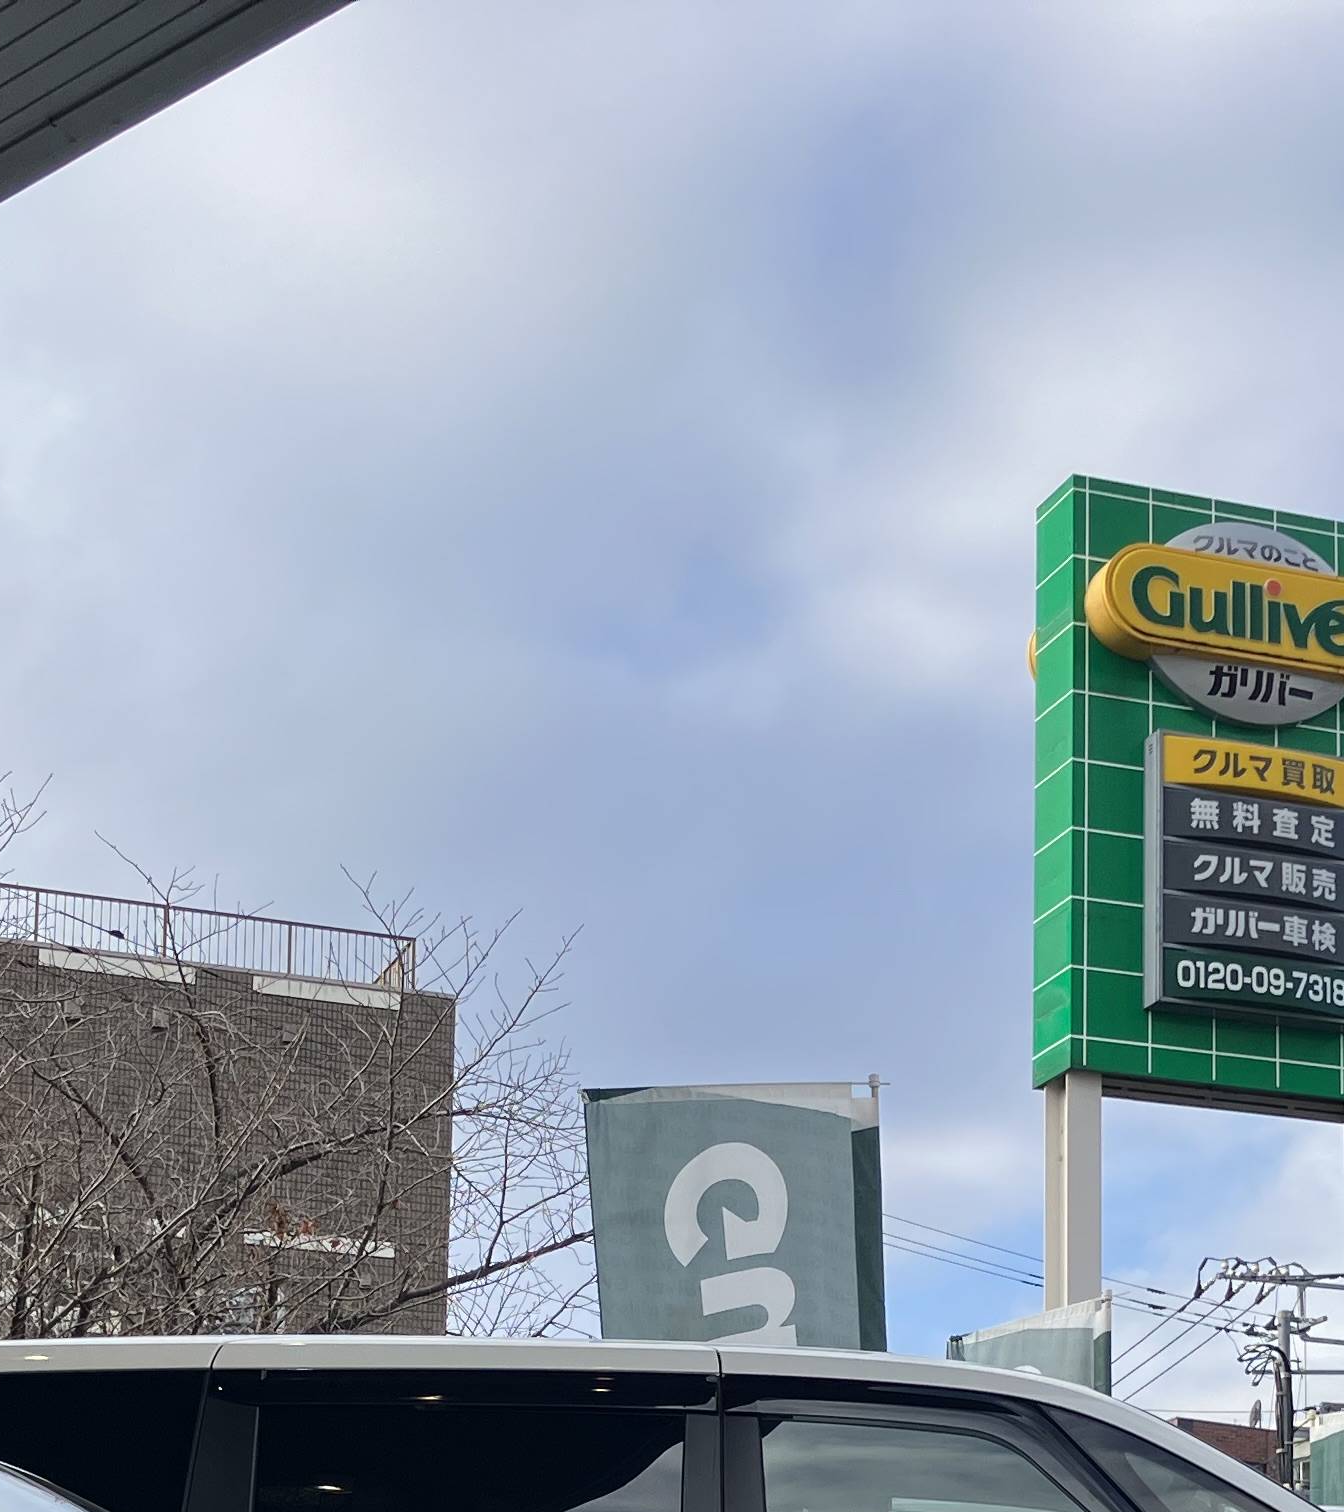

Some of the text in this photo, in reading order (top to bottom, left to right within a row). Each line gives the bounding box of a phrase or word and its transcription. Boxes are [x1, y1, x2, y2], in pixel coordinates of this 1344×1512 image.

[1192, 534, 1320, 572] クルマのこと
[1208, 665, 1313, 706] ガリバー
[1193, 749, 1336, 795] クルマ買取
[1190, 797, 1336, 848] 無料査定
[1193, 854, 1337, 901] クルマ販売
[1190, 907, 1337, 954] ガリバー車検
